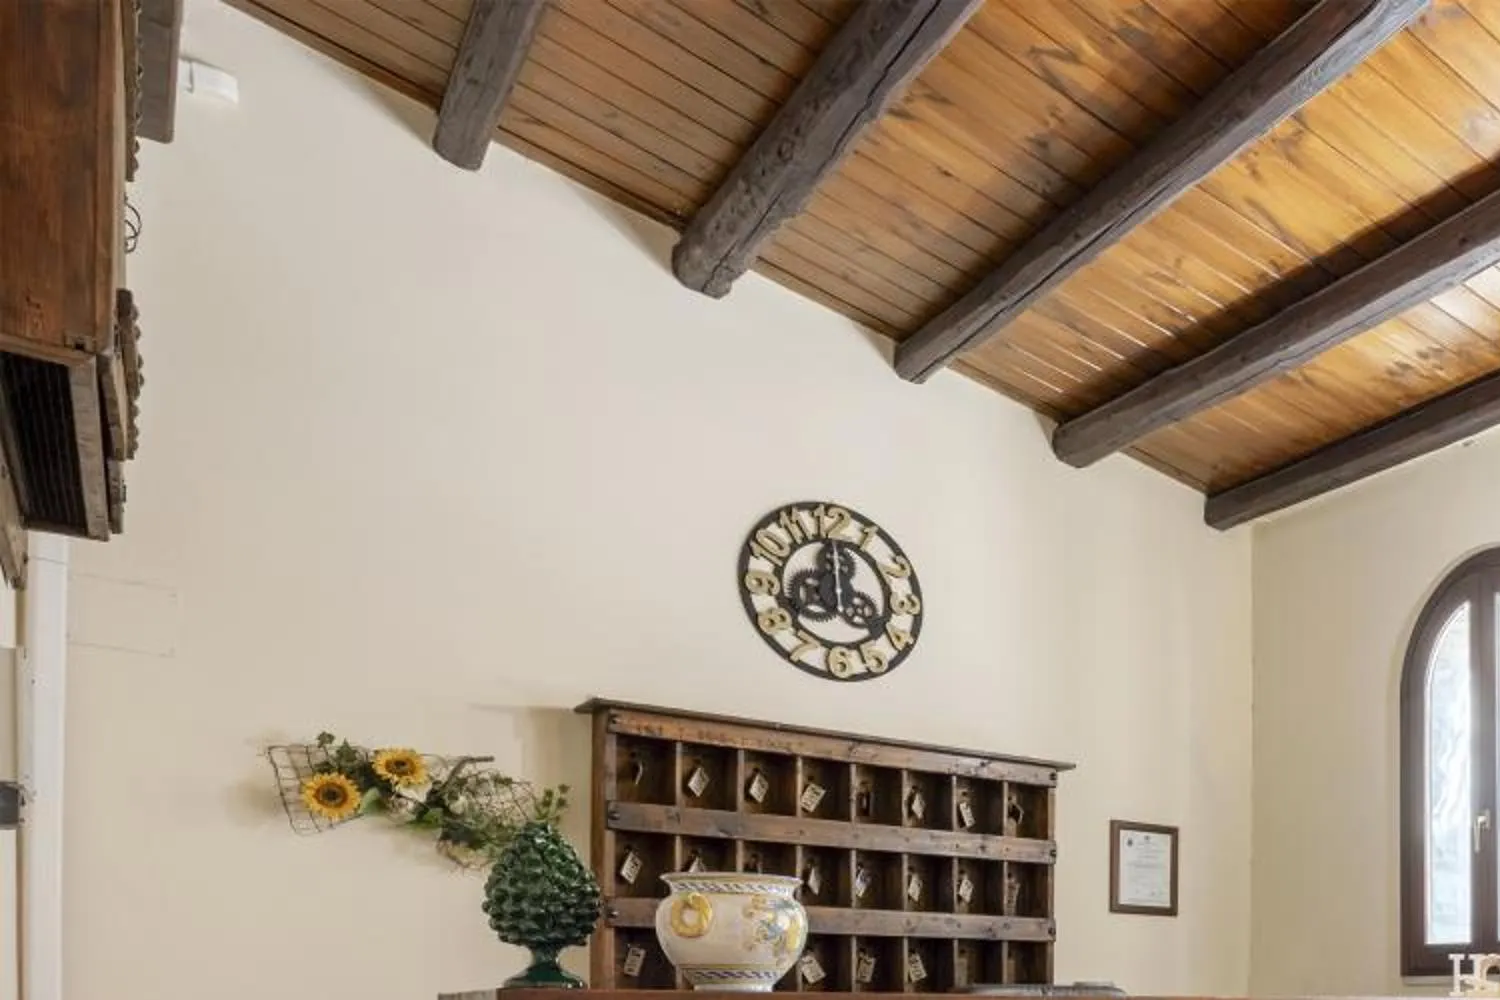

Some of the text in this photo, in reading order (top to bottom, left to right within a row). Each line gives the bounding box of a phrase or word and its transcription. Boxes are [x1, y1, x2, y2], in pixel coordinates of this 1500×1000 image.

[779, 507, 813, 545] 11
[814, 503, 851, 538] 12
[751, 527, 791, 566] 10
[859, 525, 878, 551] 1
[878, 556, 911, 579] 2
[745, 571, 780, 596] 9
[890, 592, 922, 616] 3
[758, 607, 793, 634] 8
[789, 629, 820, 662] 7
[886, 624, 913, 650] 4
[828, 647, 852, 679] 6
[859, 643, 889, 673] 5
